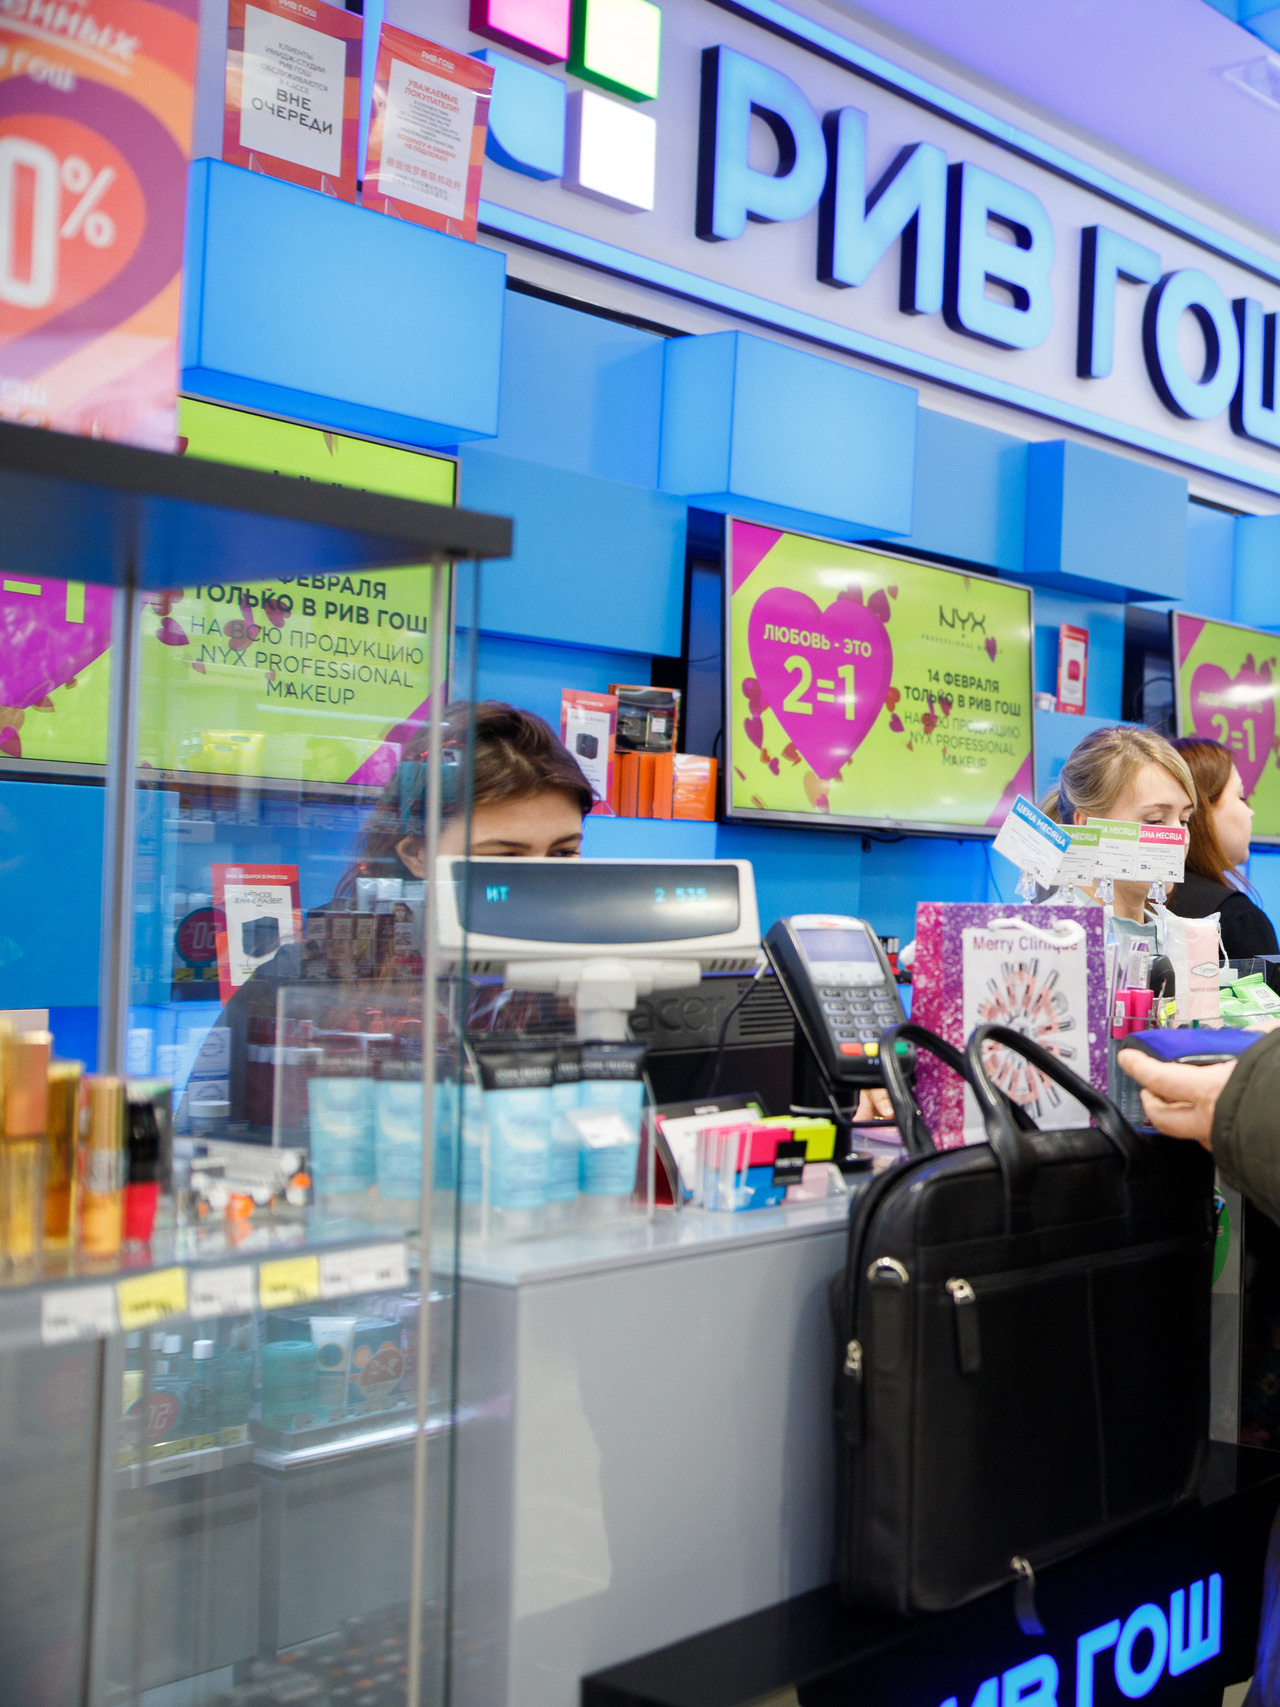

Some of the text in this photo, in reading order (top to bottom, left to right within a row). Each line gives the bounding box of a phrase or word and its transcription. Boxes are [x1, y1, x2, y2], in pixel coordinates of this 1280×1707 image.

[298, 4, 317, 18] ГОШ
[421, 50, 437, 63] РИВ
[276, 88, 312, 112] ВНЕ
[408, 79, 459, 105] УВАЖАЕМЫЕ
[251, 97, 333, 136] ОЧЕРЕДИ
[695, 43, 1056, 351] РИВ
[302, 597, 317, 617] В
[324, 601, 370, 626] РИВ
[377, 609, 428, 634] ГОШ
[939, 605, 986, 635] NYX
[190, 616, 424, 664] НА ВСЮ ПРОДУКЦИЮ
[763, 624, 831, 651] ЛЮБОВЬ
[843, 638, 872, 658] ЭТО
[200, 644, 414, 688] NYX PROFESSIONAL
[266, 680, 355, 705] MAKEUP
[783, 655, 855, 721] 2=1
[928, 669, 1000, 694] 14 ФЕВРАЛЯ
[904, 685, 1021, 717] ТОЛЬКО В РИВ ГОШ
[904, 711, 920, 725] НА
[909, 731, 1016, 757] NYX PROFESSIONAL
[942, 754, 987, 770] MAKEUP
[1015, 802, 1067, 847] ЦЕНА МЕСЯЦА
[1071, 832, 1098, 842] МЕСЯЦА
[1110, 827, 1137, 836] МЕСЯЦА
[1156, 831, 1183, 841] МЕСЯЦА
[653, 887, 666, 903] 2
[972, 936, 1014, 954] Merry
[1075, 1571, 1222, 1707] ГОШ
